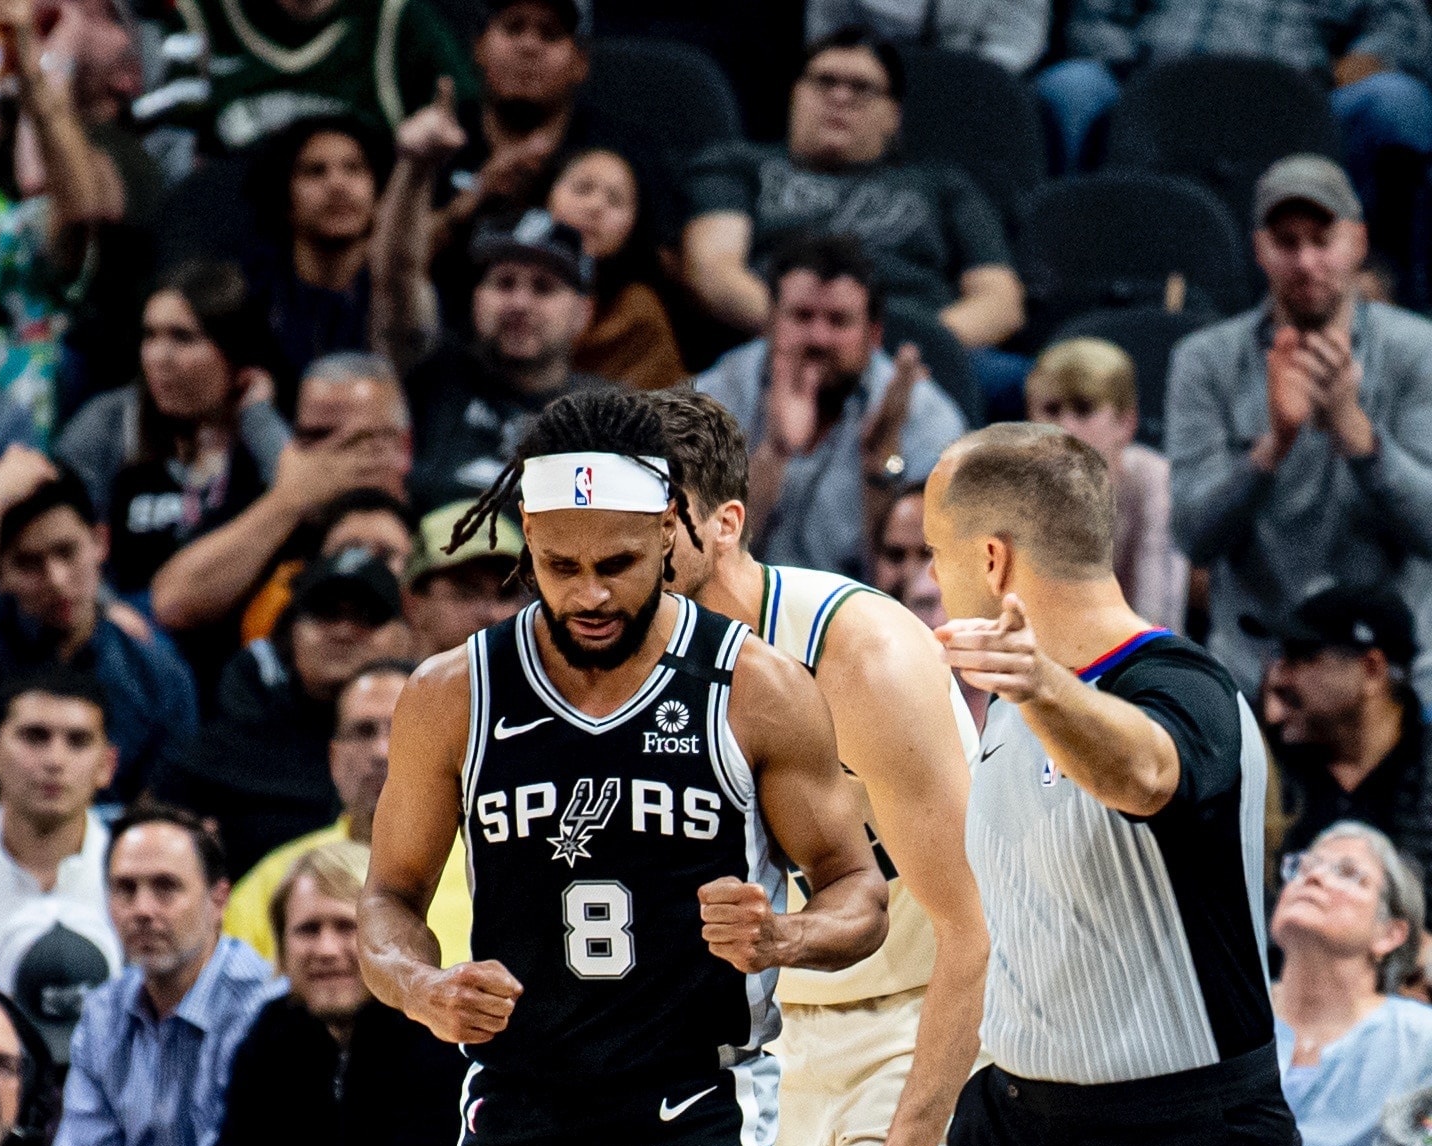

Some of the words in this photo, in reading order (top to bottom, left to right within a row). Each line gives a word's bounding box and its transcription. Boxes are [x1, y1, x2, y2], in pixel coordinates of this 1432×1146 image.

[642, 731, 700, 754] Frost
[477, 778, 721, 868] SPURS
[561, 879, 636, 980] 8
